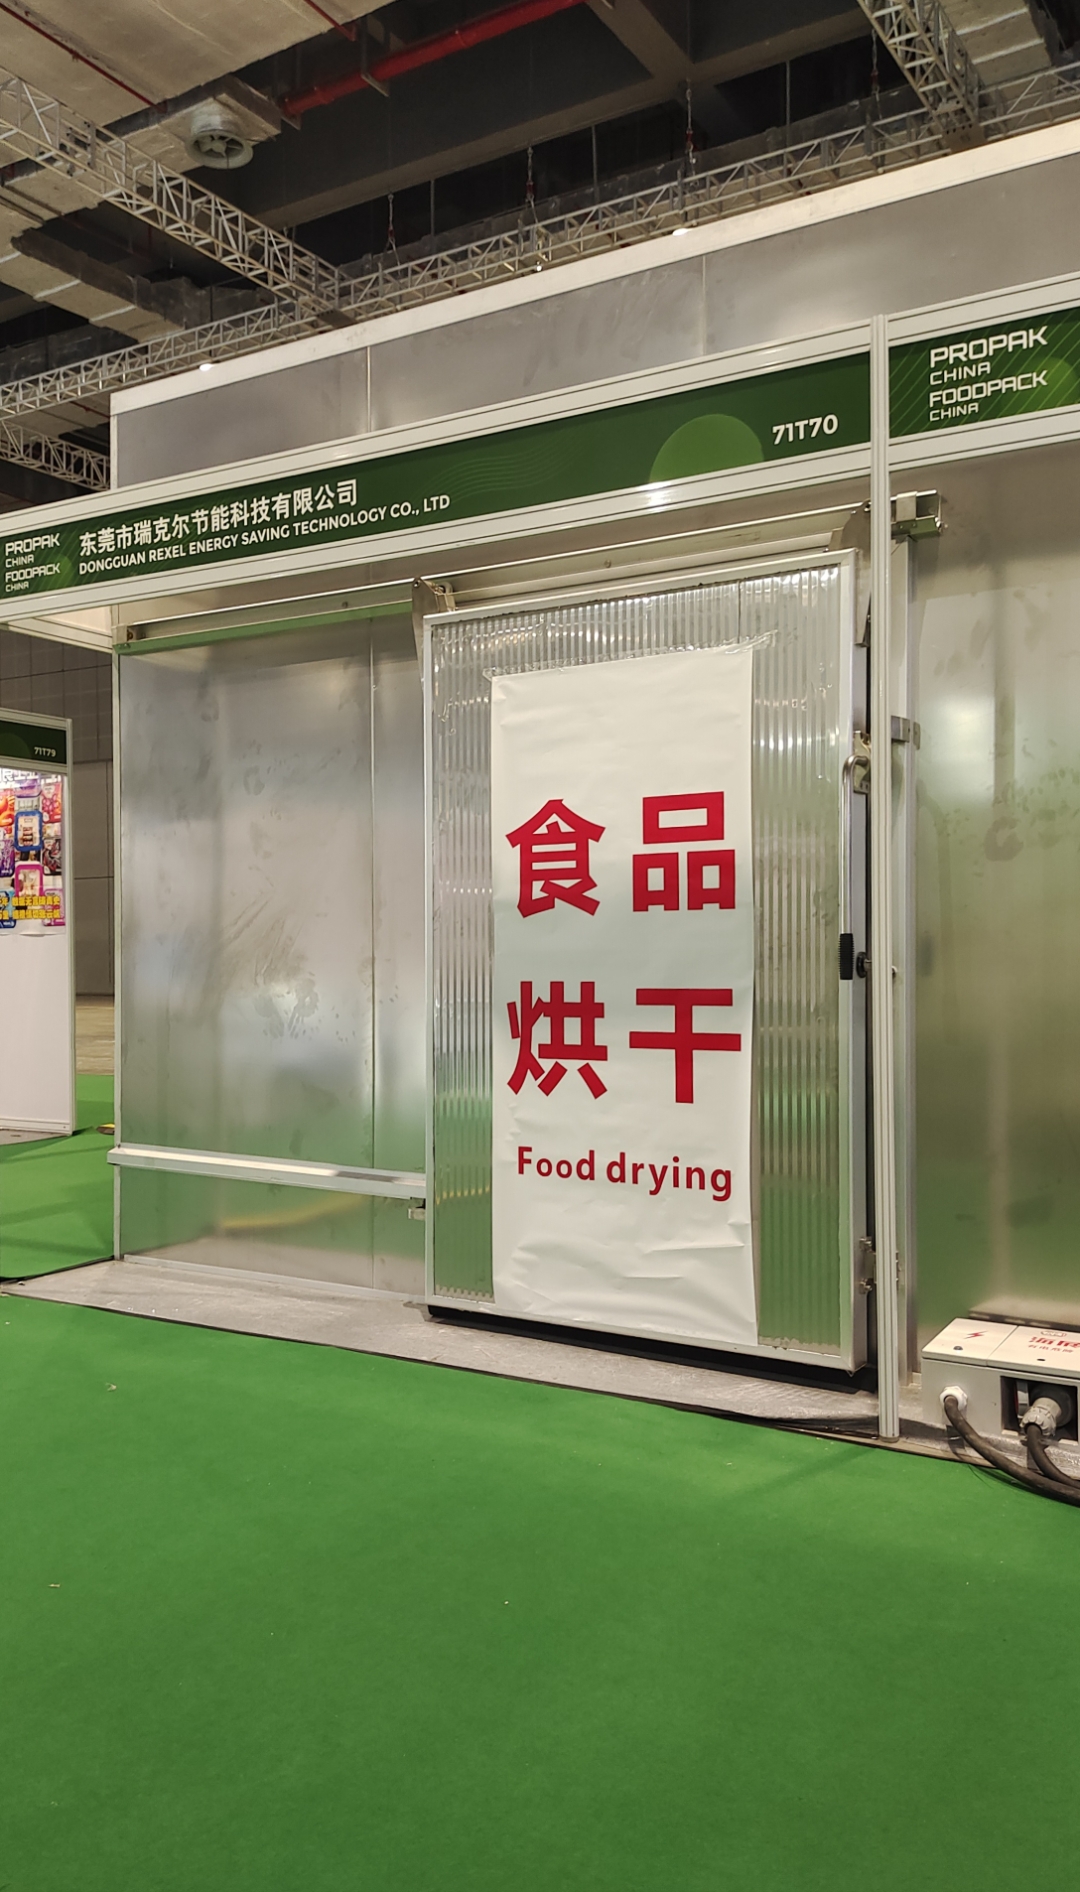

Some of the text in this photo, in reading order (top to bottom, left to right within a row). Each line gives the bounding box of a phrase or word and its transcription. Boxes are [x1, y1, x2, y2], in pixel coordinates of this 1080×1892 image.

[930, 326, 1048, 368] PROPAK
[930, 362, 991, 385] CHINA
[929, 370, 1048, 408] FOODPACK
[929, 403, 979, 422] CHINA
[772, 415, 839, 445] 71T70
[79, 479, 357, 556] 东莞市瑞克尔节能科技有限公司
[5, 533, 60, 556] PROPAK
[79, 494, 451, 575] DONGGUAN REXEL ENERGY SAVING TECHNOLOGY CO., LTD
[5, 554, 34, 568] CHINA
[5, 563, 60, 582] FOODPACK
[5, 581, 29, 592] CHINA
[34, 747, 56, 757] 71T79
[505, 791, 736, 918] 食品
[507, 981, 742, 1104] 烘干
[517, 1146, 732, 1202] Food drying
